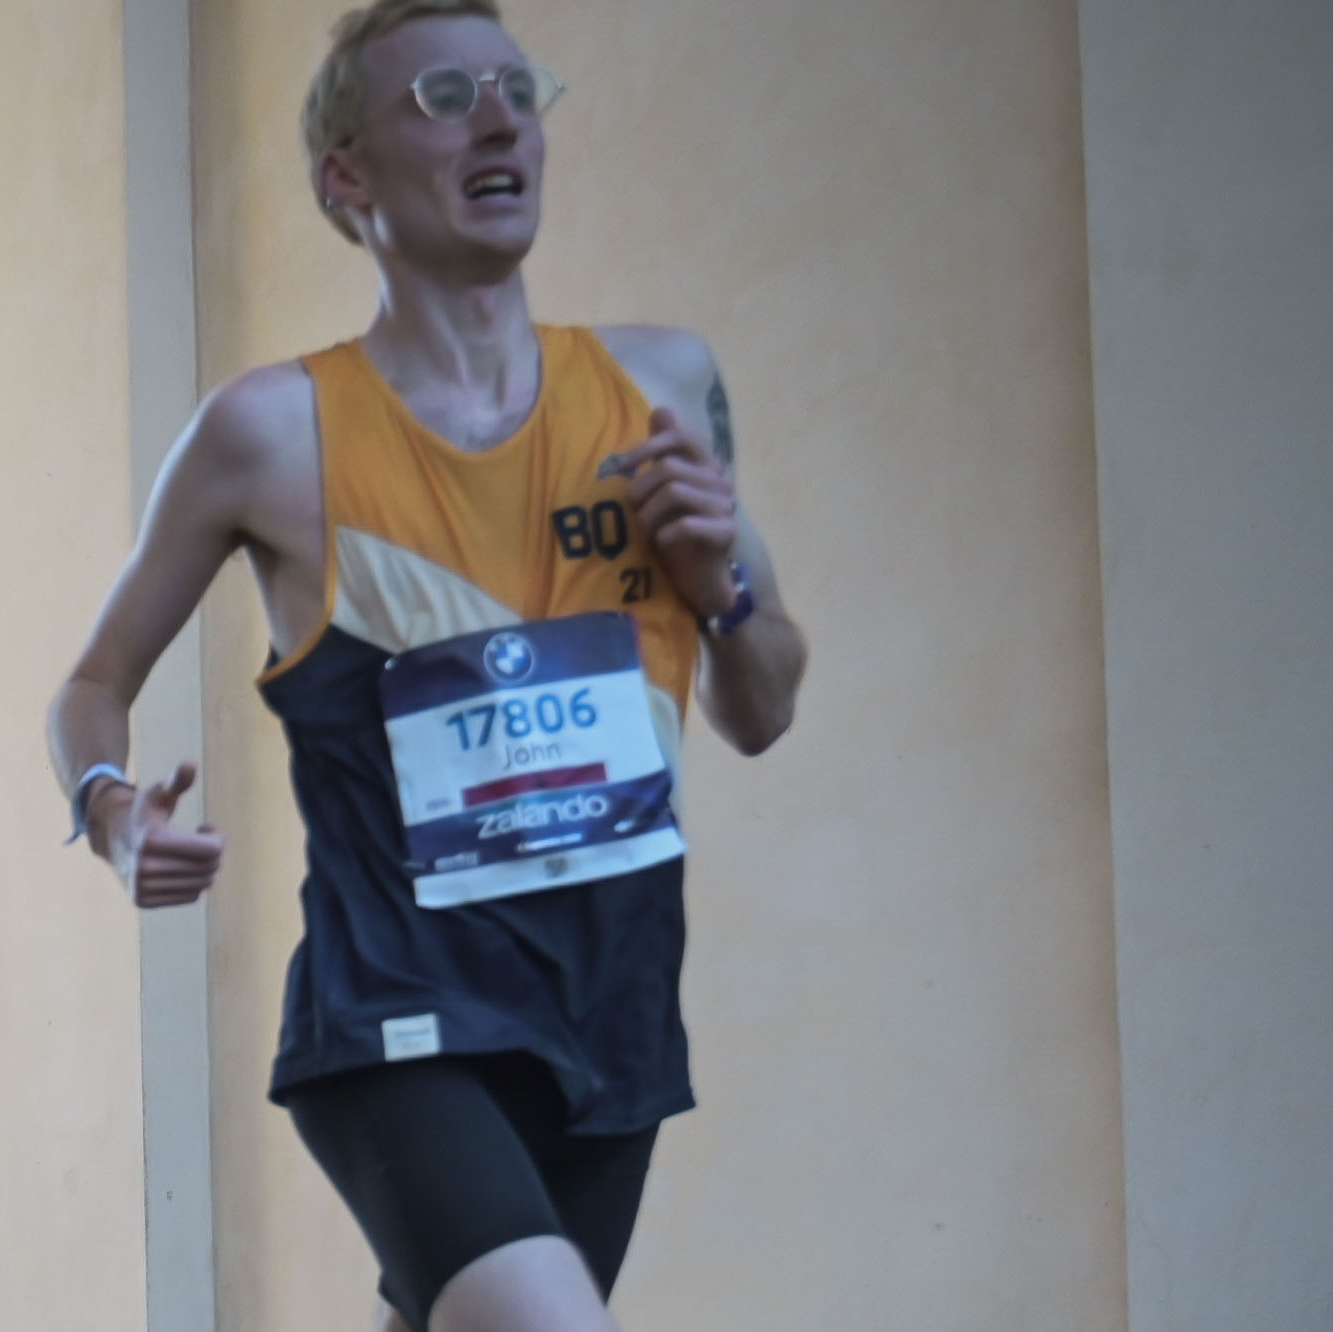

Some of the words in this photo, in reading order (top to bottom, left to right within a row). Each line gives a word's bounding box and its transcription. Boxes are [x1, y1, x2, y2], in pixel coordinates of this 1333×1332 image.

[446, 687, 597, 752] 17806
[502, 742, 563, 769] John
[476, 793, 608, 840] zalando
